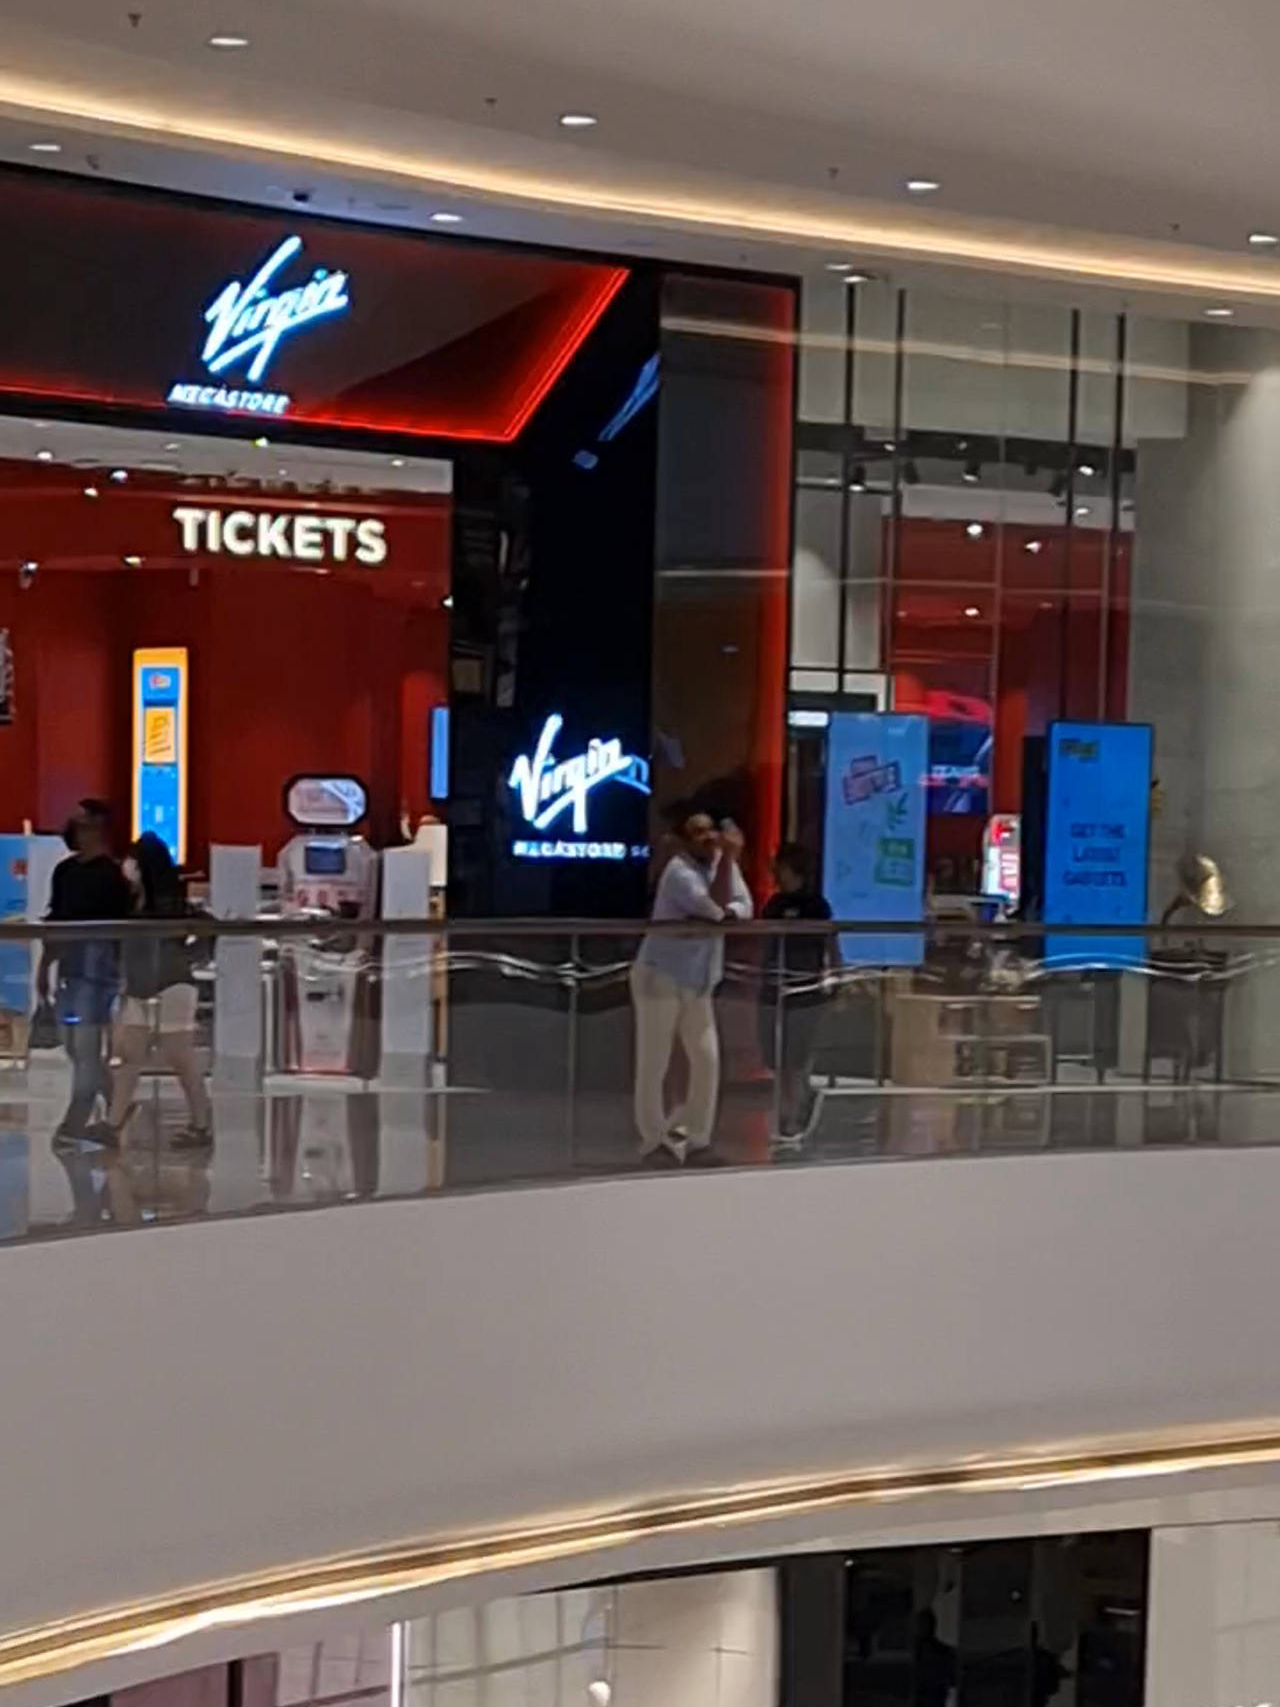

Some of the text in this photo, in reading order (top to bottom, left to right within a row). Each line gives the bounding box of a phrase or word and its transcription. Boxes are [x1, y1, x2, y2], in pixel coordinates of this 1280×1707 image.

[202, 236, 349, 382] Virgin
[173, 506, 388, 564] TICKETS
[507, 713, 633, 834] Virgin
